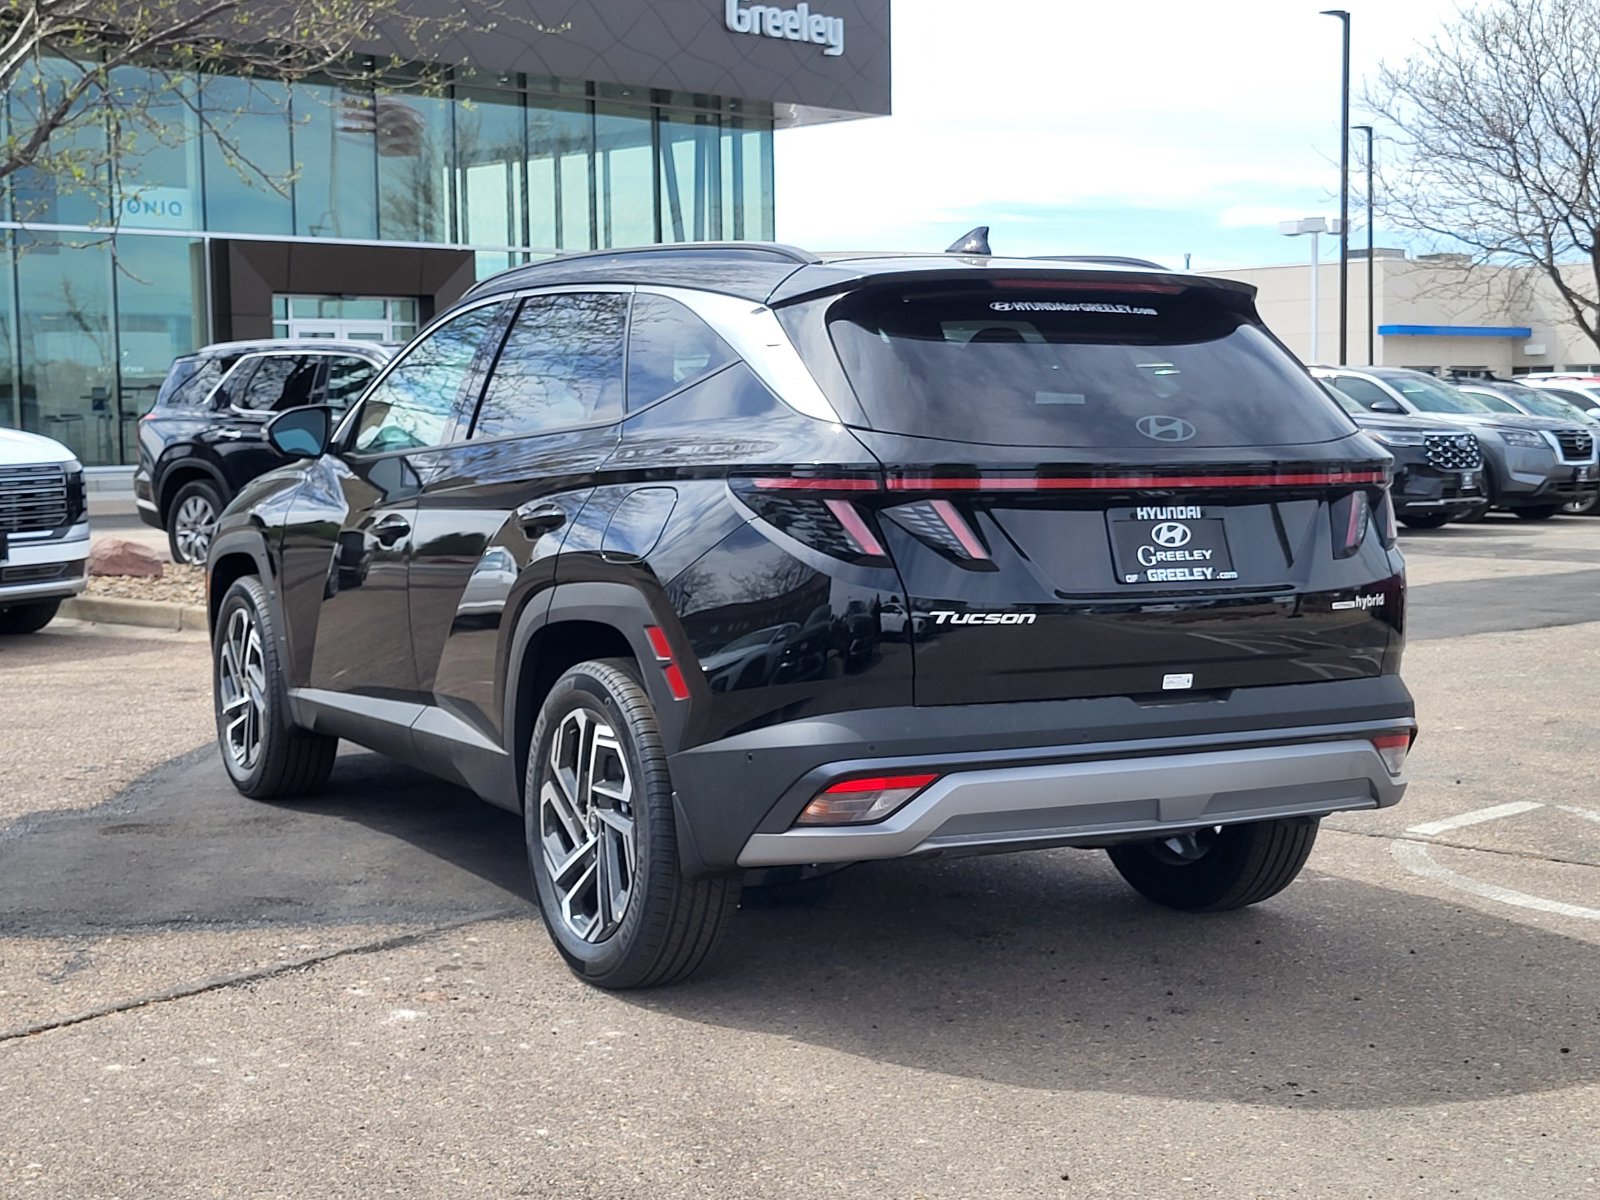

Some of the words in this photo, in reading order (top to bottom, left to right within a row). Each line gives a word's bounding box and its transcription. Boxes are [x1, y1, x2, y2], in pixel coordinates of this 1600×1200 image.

[725, 0, 844, 56] Greeley
[121, 199, 182, 216] ONIQ
[1136, 506, 1202, 520] HYUNDAI
[1125, 574, 1139, 583] OF
[1146, 567, 1213, 582] GREELEY
[1355, 593, 1385, 610] hybrid
